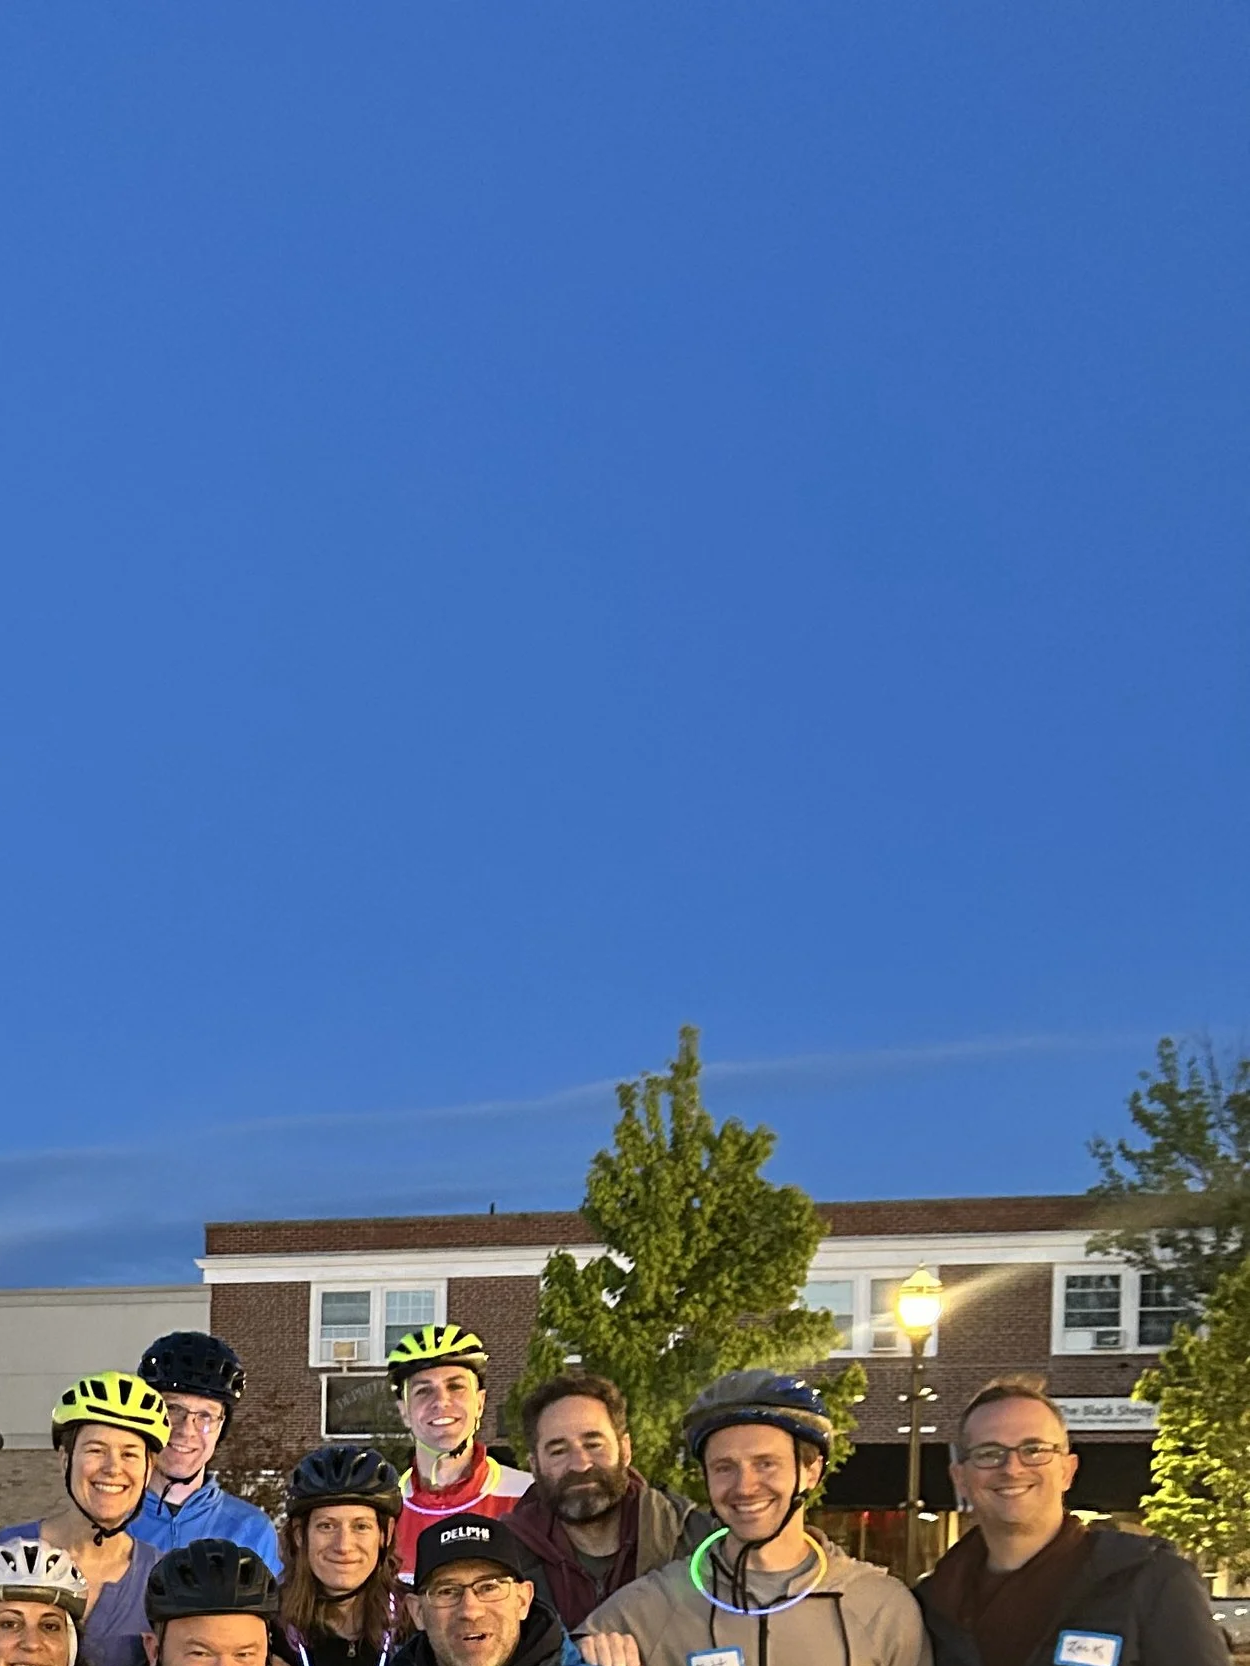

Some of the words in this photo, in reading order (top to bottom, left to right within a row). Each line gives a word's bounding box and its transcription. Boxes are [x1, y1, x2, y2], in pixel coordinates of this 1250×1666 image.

[1083, 1404, 1113, 1416] Black
[1117, 1404, 1155, 1418] Sheep
[440, 1526, 490, 1544] DELPHI
